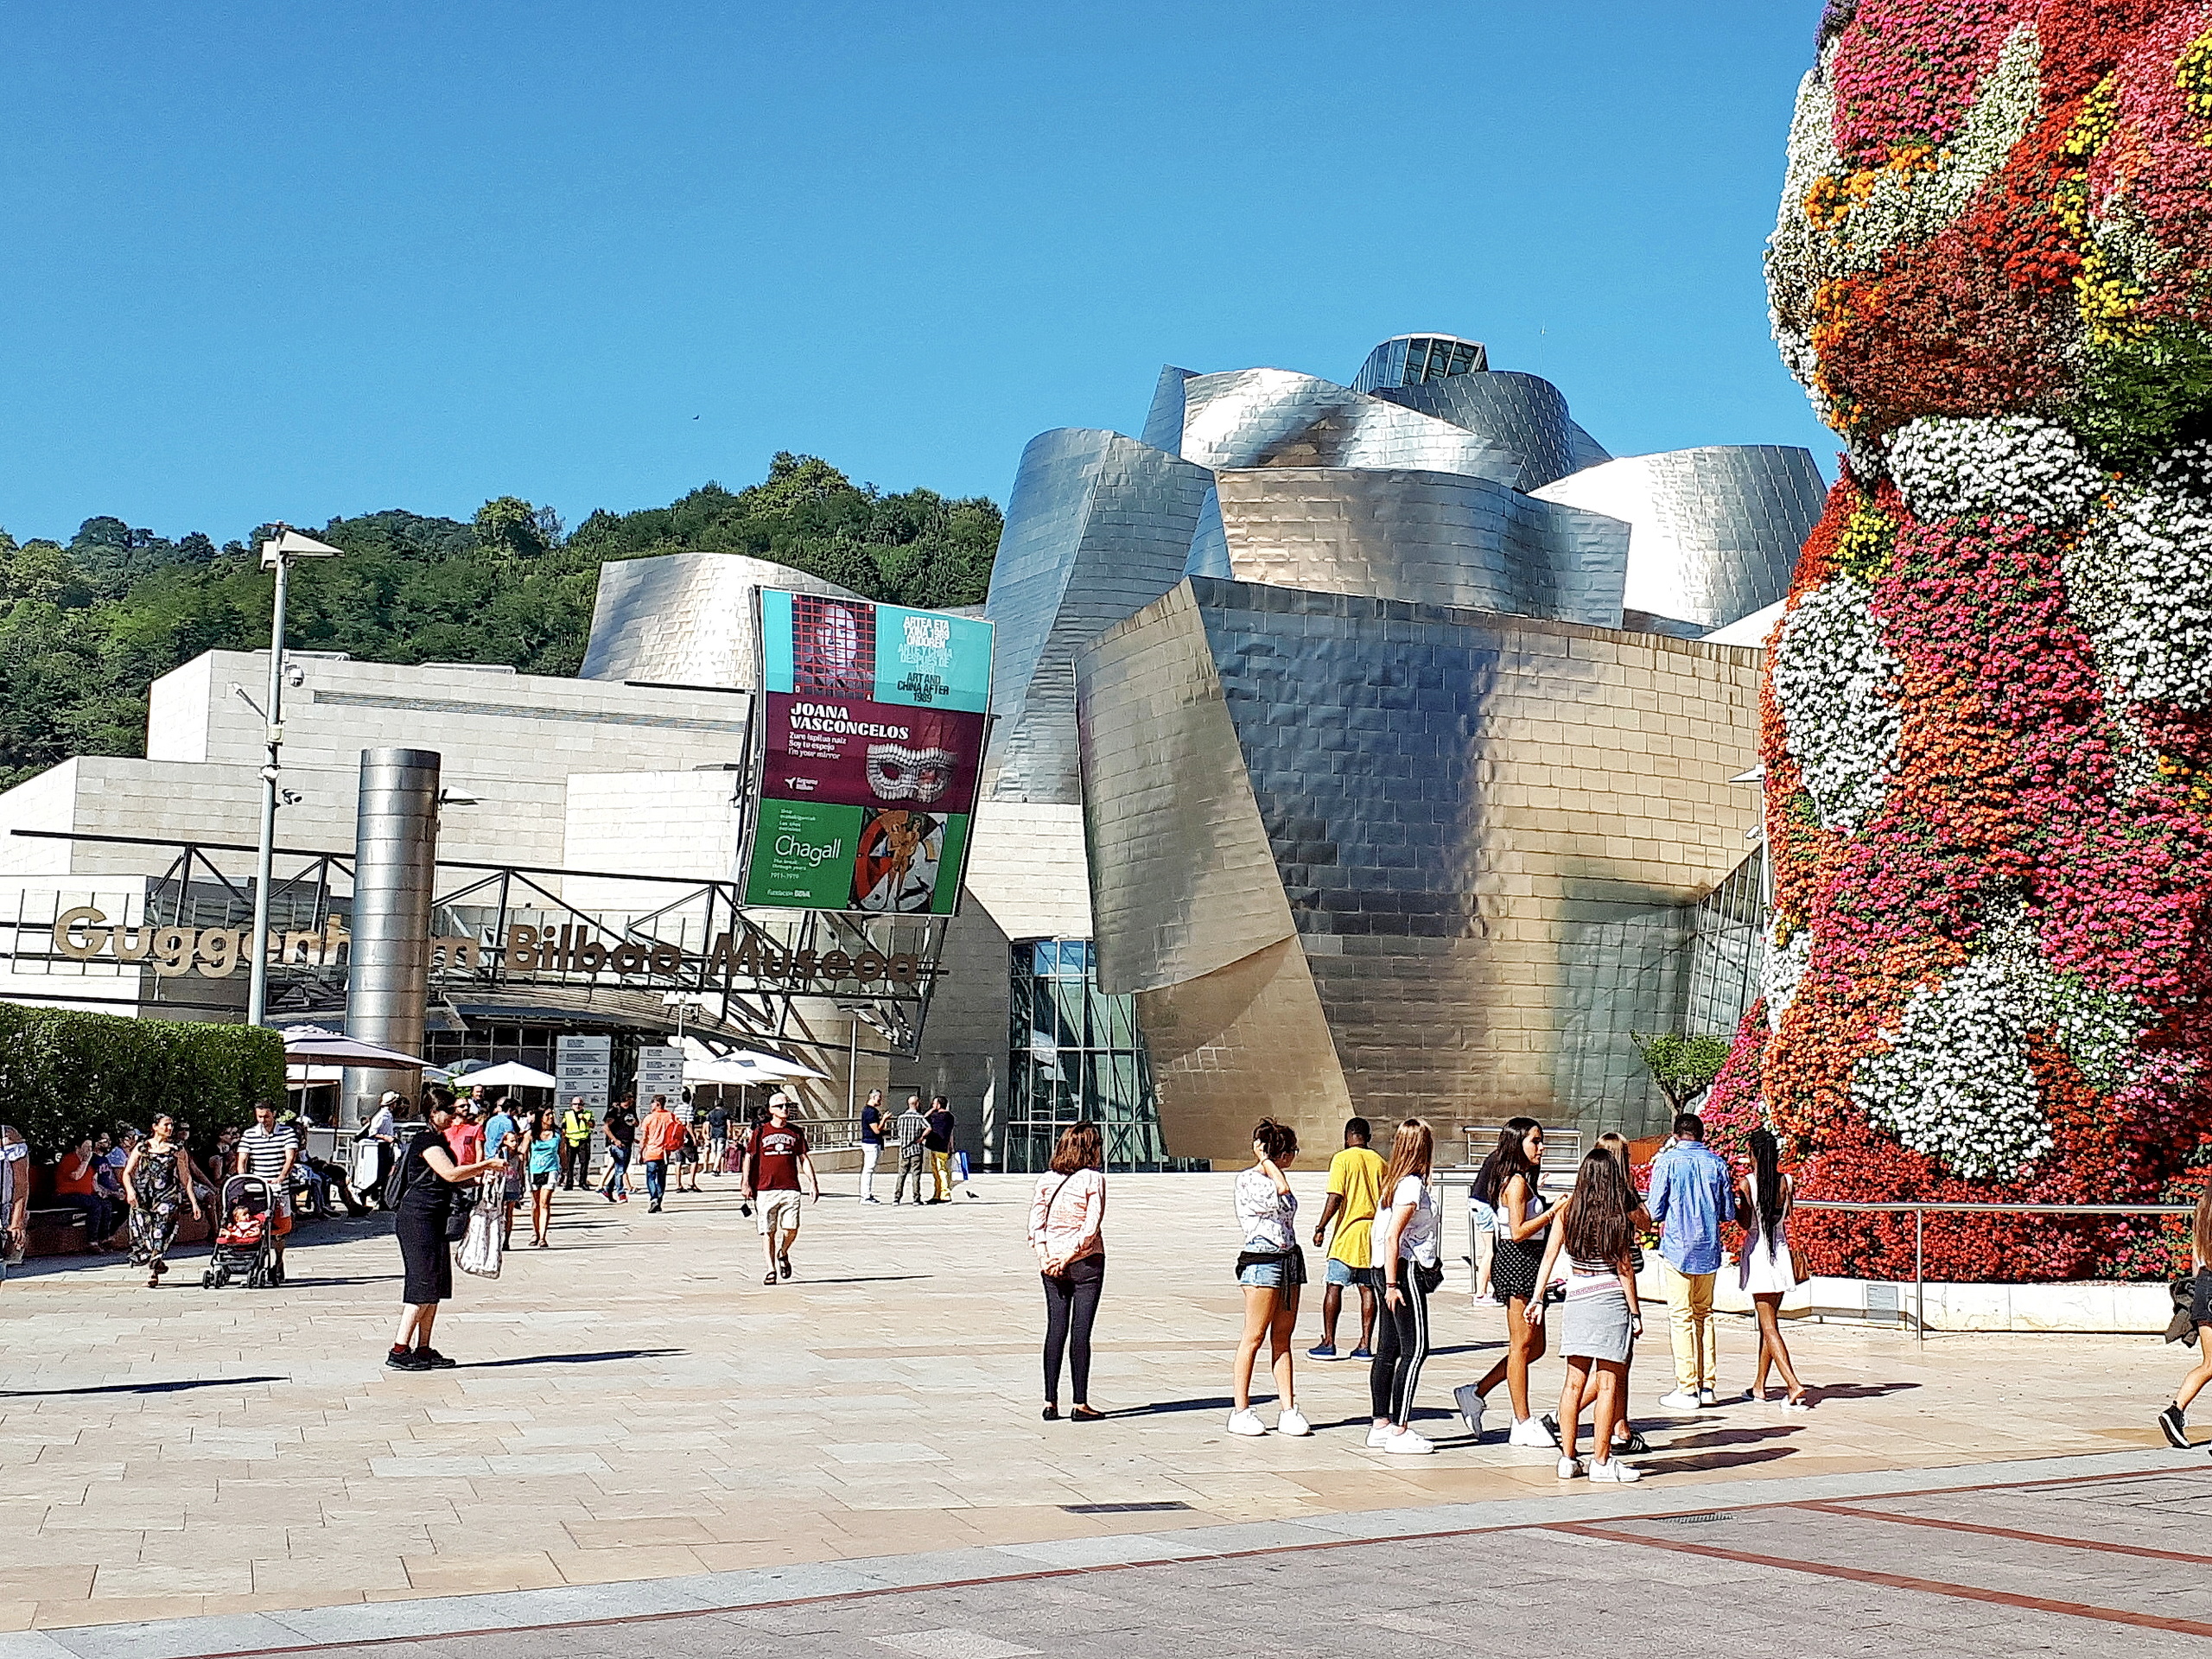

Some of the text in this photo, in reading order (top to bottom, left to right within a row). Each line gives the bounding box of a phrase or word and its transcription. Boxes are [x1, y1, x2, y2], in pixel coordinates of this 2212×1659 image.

[903, 616, 950, 631] ARTEA ETA
[906, 672, 941, 685] ART AND
[897, 681, 950, 696] CHINA AFTER
[913, 692, 933, 703] 1989
[791, 702, 849, 721] JOANA
[790, 715, 910, 741] VASCONCELOS
[788, 740, 802, 748] Soy
[811, 743, 836, 752] espejo
[799, 750, 817, 759] your
[817, 751, 841, 760] mirror
[775, 835, 842, 868] Chagall
[54, 906, 919, 983] Guggenhm Bilbao Museoa
